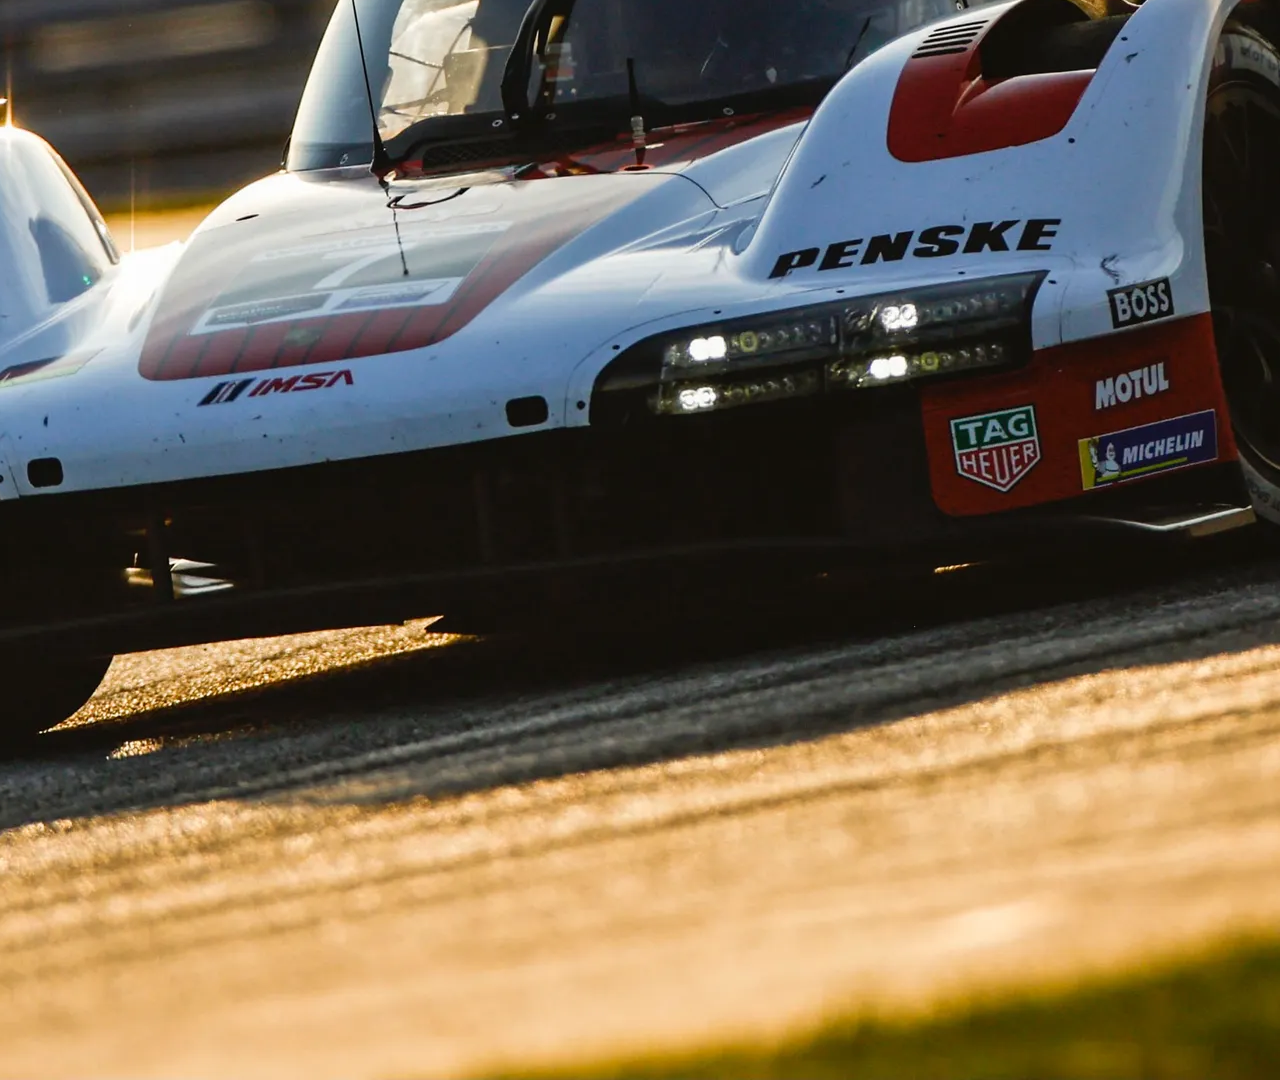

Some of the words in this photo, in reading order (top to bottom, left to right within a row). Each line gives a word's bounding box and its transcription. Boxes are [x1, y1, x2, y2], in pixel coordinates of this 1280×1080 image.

[767, 218, 1062, 280] PENSKE
[1113, 282, 1170, 322] BOSS
[248, 369, 354, 398] IMSA
[1095, 362, 1170, 410] MOTUL
[959, 413, 1030, 446] TAG
[1122, 429, 1205, 466] MICHELIN
[962, 444, 1037, 486] HEUER
